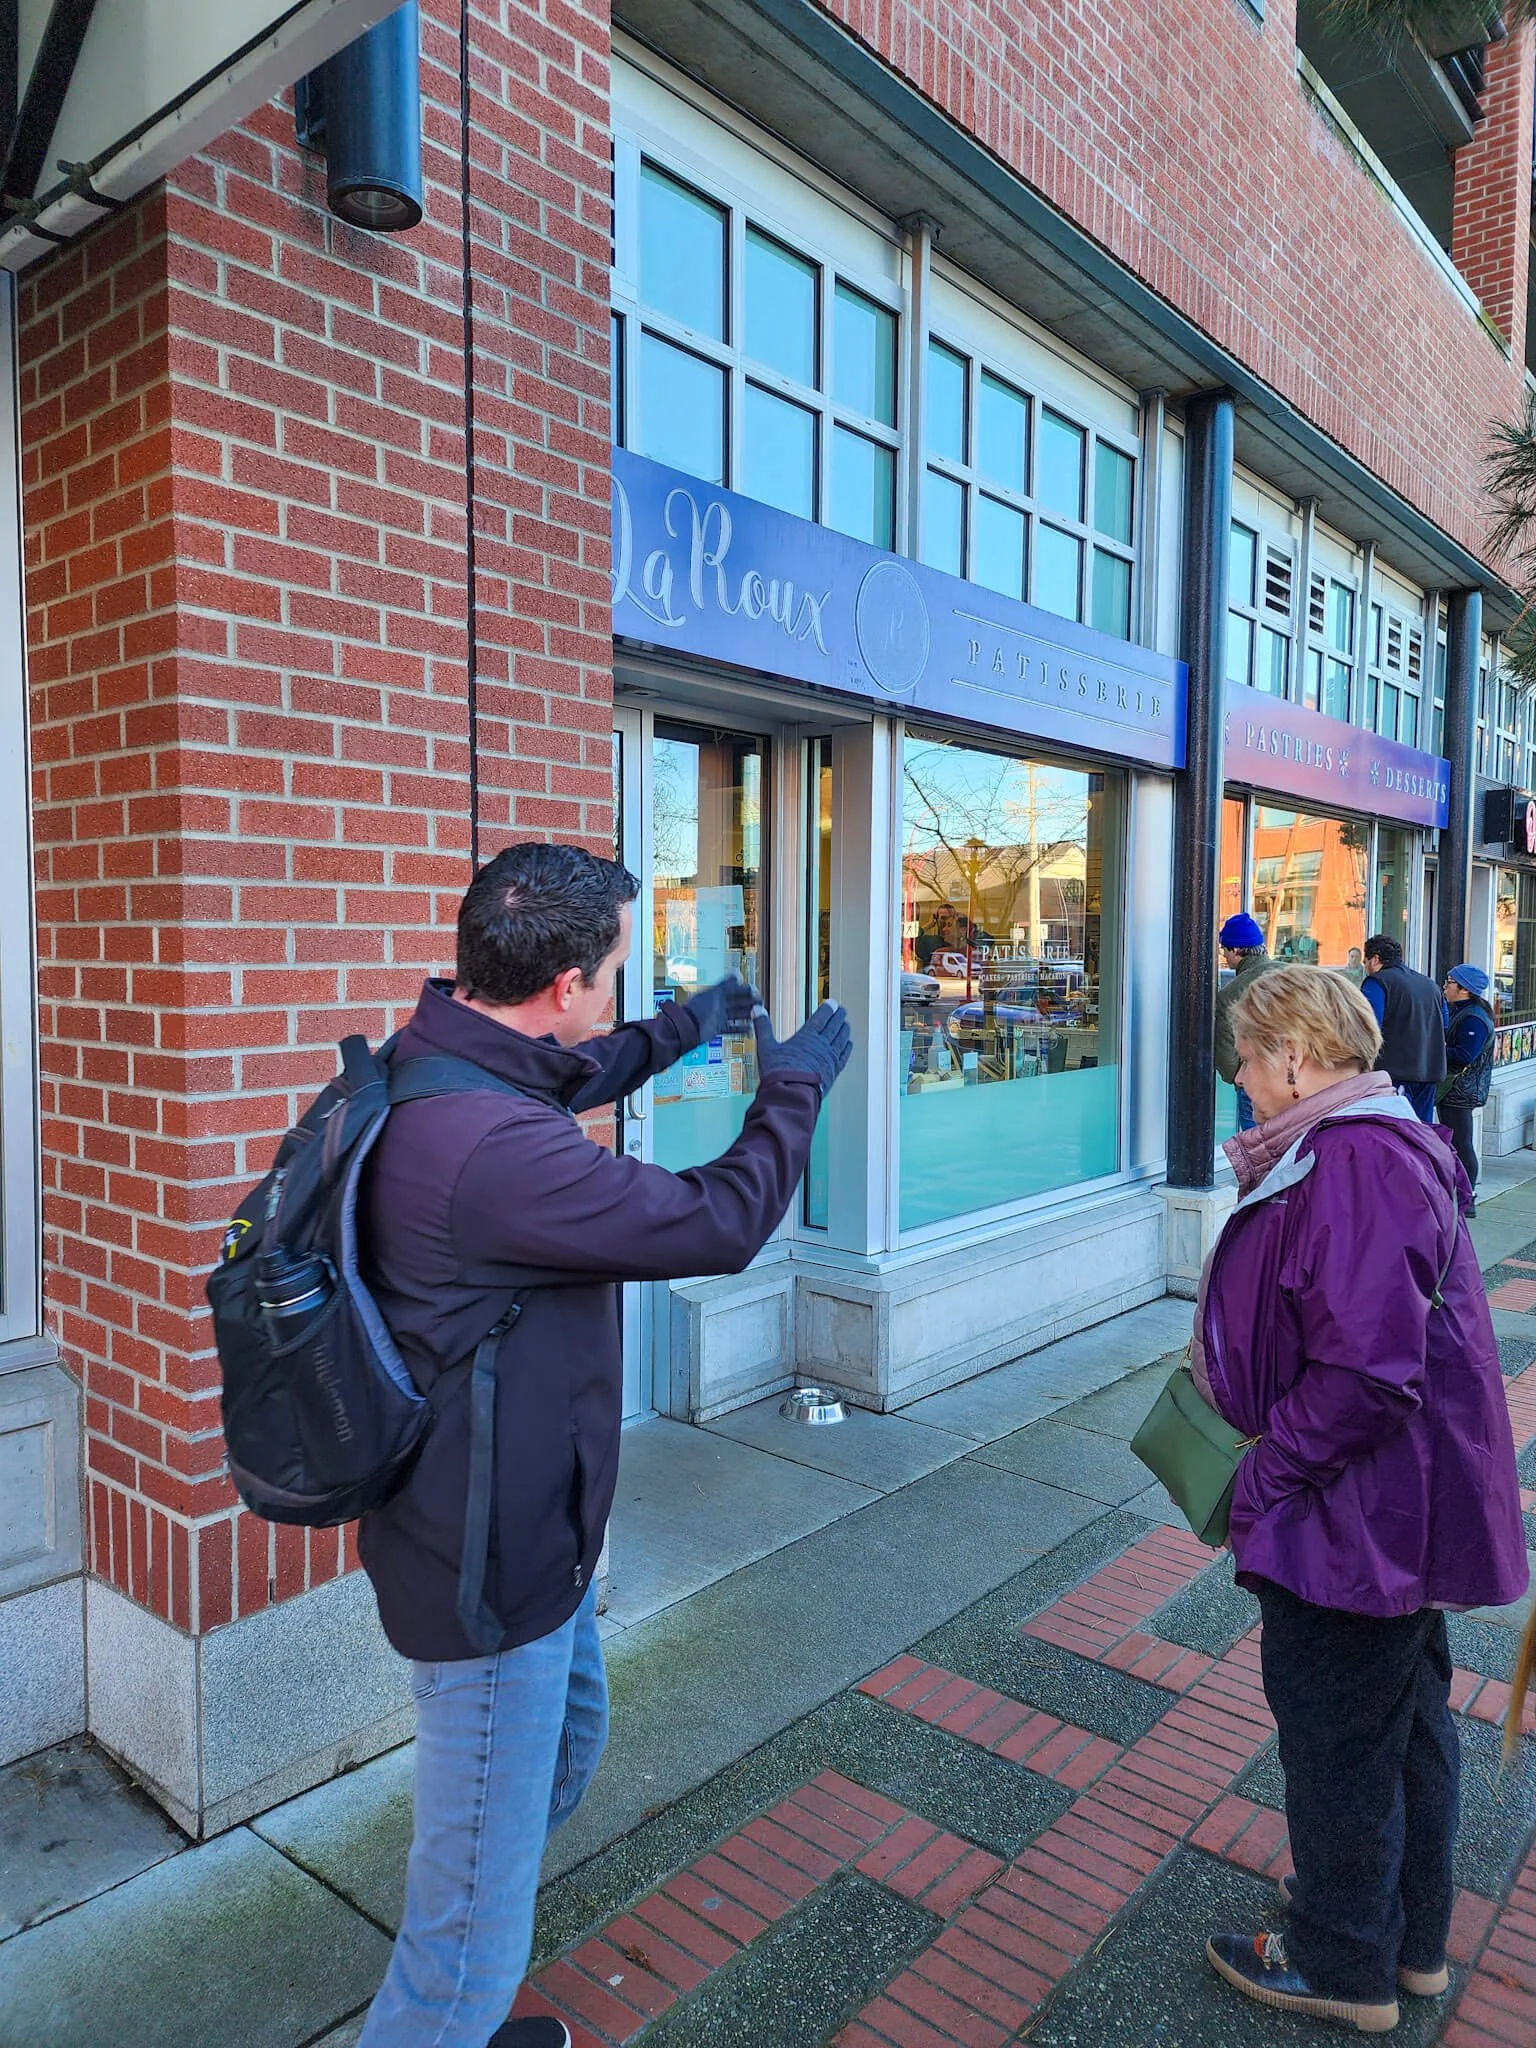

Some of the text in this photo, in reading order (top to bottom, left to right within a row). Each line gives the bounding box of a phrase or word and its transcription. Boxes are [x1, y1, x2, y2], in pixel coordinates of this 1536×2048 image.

[664, 488, 831, 656] Roux
[968, 639, 1161, 718] PATISSERIE
[1245, 721, 1448, 804] PASTRIES DESSERTS
[1007, 973, 1036, 981] PASTRIES
